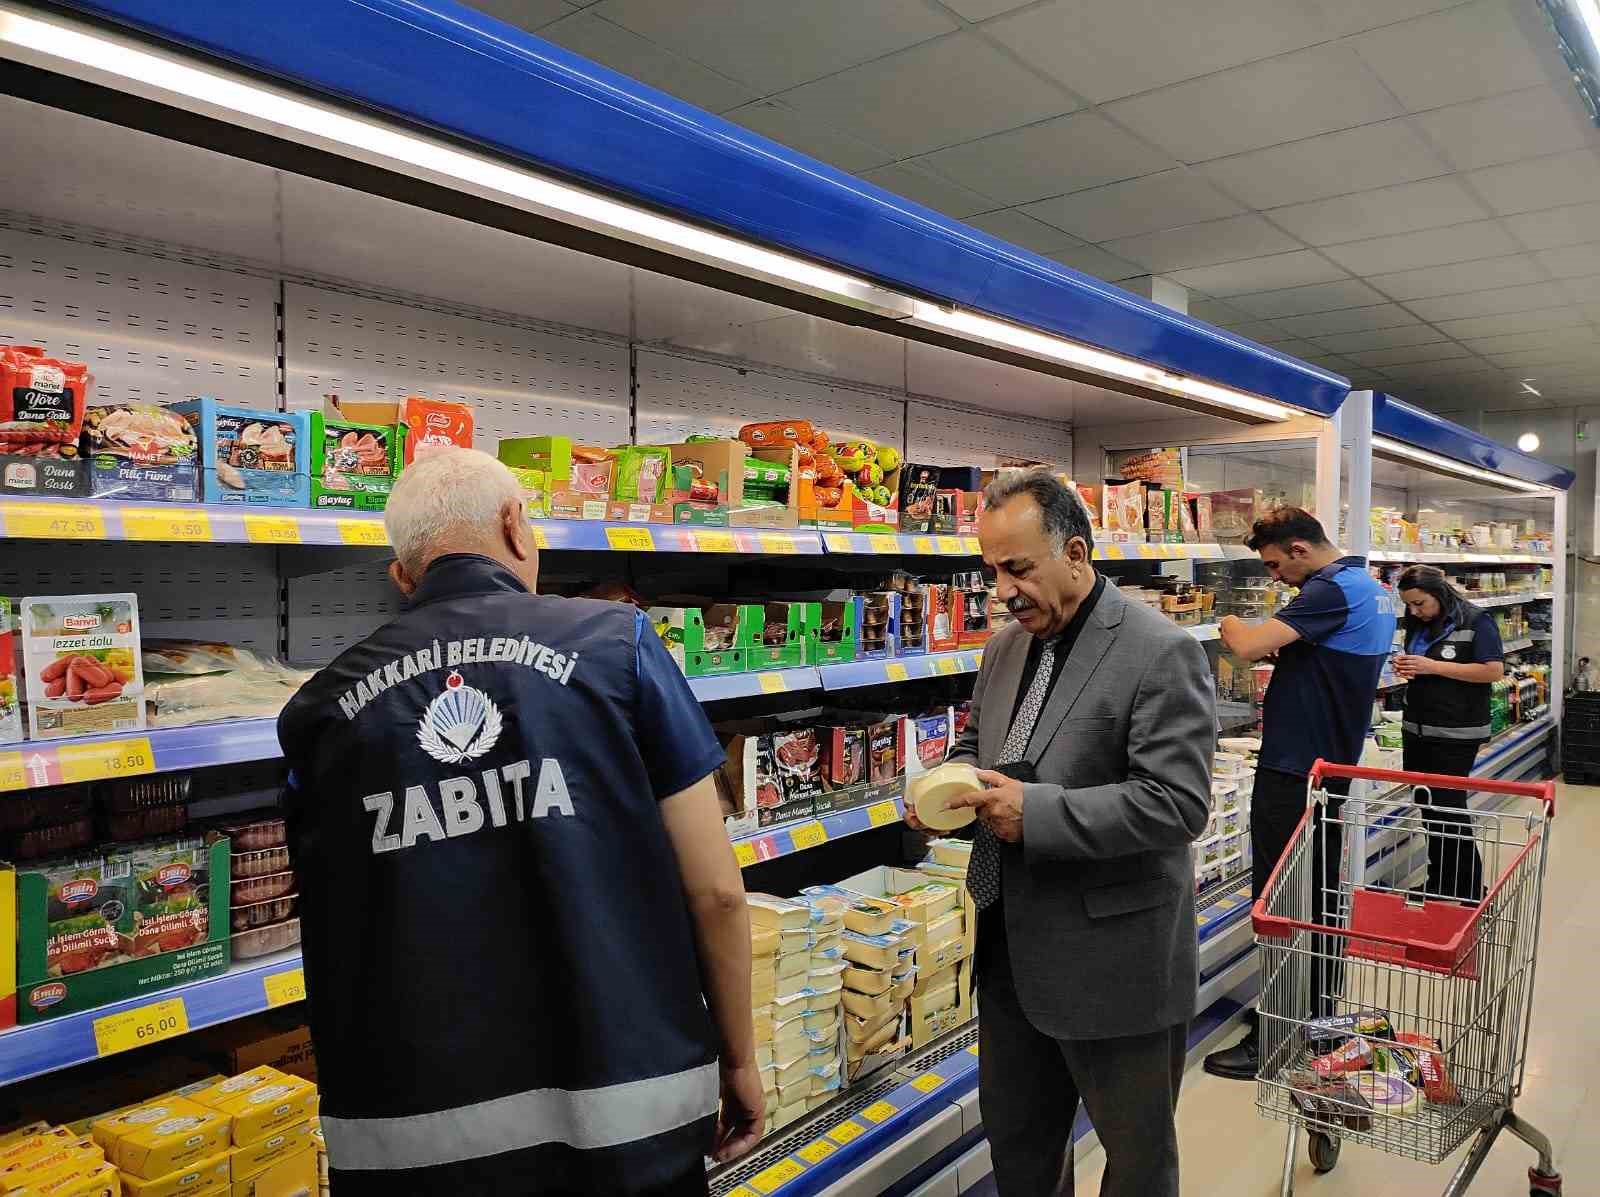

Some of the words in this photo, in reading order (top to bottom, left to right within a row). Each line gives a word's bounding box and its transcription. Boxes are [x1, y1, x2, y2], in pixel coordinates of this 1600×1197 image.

[25, 391, 61, 410] Yöre
[128, 452, 162, 463] NAMET
[43, 464, 76, 478] Dana
[119, 467, 143, 480] Piliç
[43, 477, 76, 491] Sosis
[65, 617, 98, 628] Banvit
[52, 637, 86, 649] lezzet
[89, 635, 113, 647] dolu
[338, 638, 443, 721] HAKKARİ
[446, 635, 579, 686] BELEDİYESİ
[362, 758, 576, 854] ZABITA
[159, 866, 187, 880] Emin
[62, 883, 95, 898] Emin
[138, 926, 157, 937] Dana
[160, 920, 188, 933] Dilimli
[62, 940, 93, 953] Dilimli
[93, 934, 120, 947] Sucuk
[32, 985, 63, 1000] Emin
